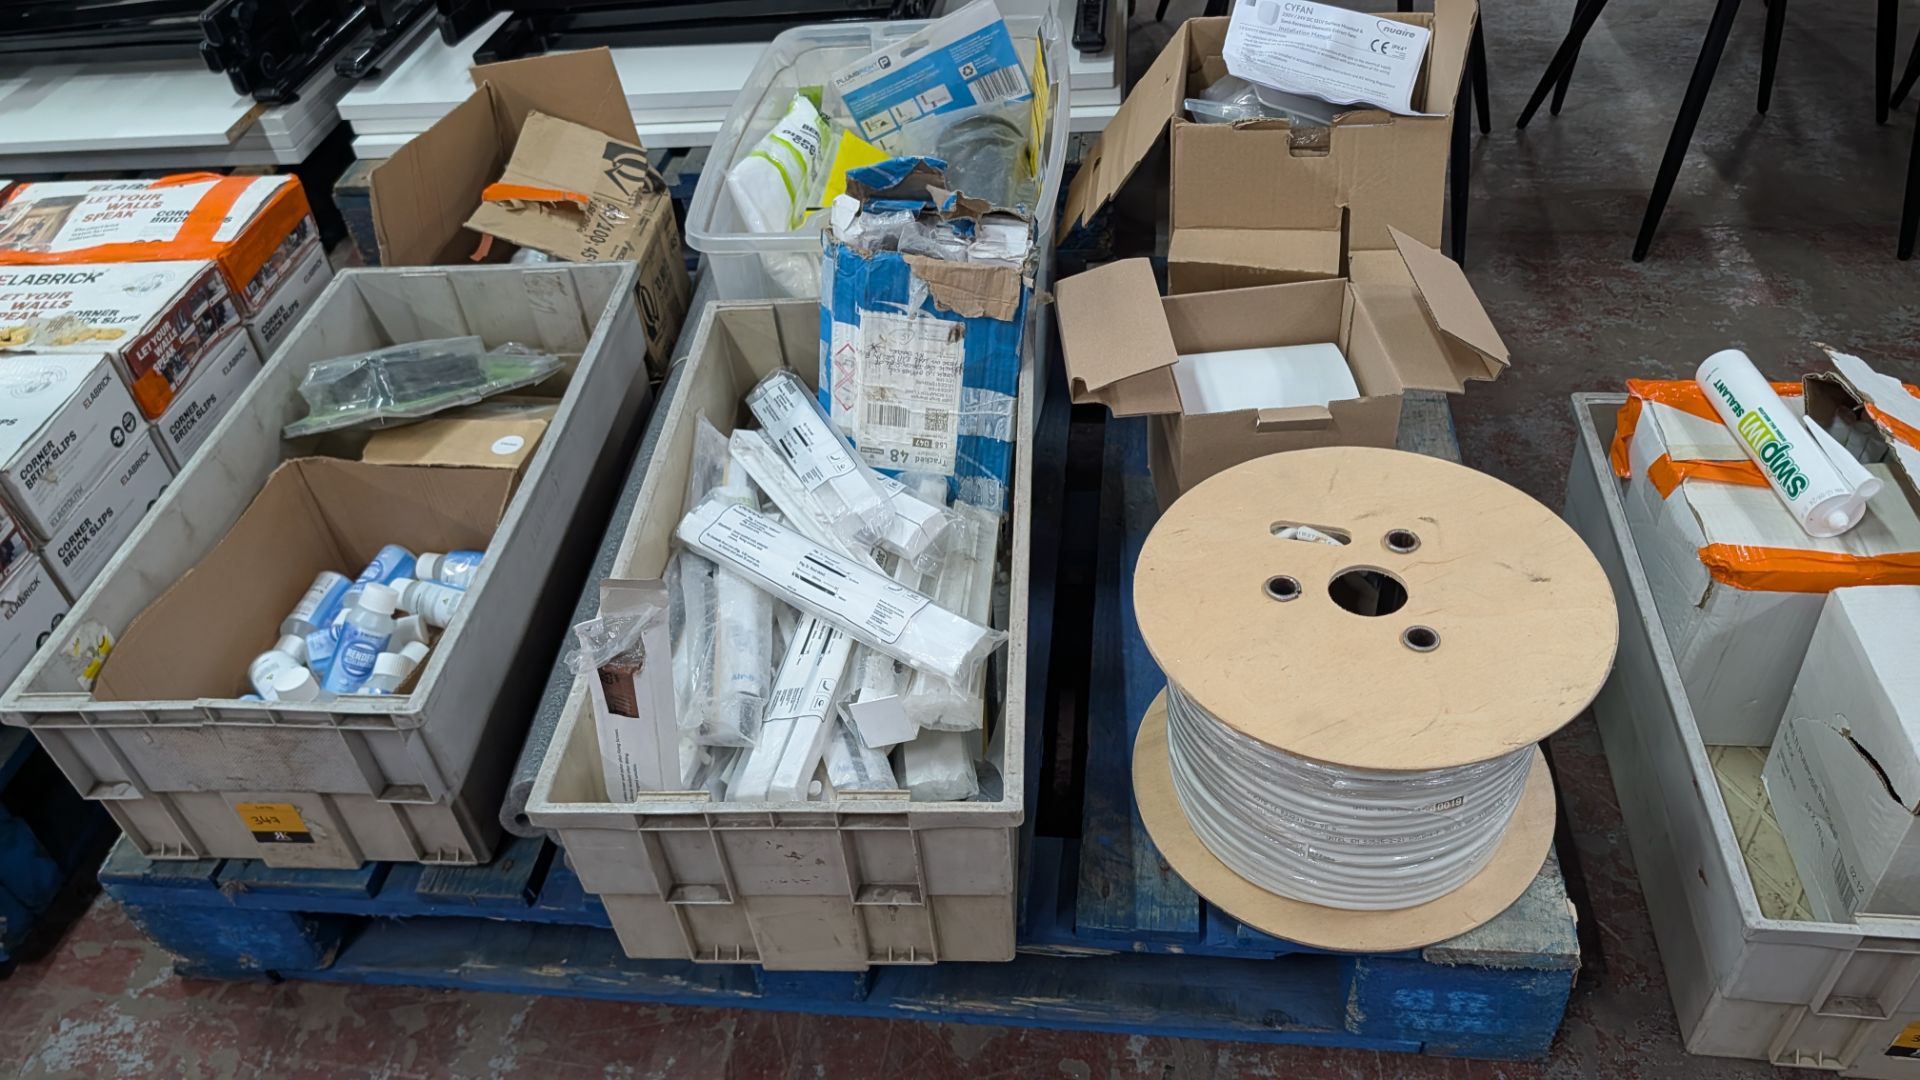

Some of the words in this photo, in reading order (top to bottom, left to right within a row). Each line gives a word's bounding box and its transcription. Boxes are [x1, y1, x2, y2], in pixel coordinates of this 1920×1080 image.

[1284, 2, 1314, 15] CYFAN
[1383, 25, 1416, 39] nuaire
[87, 194, 121, 204] LET
[119, 193, 163, 202] YOUR
[105, 201, 163, 211] WALLS
[82, 211, 136, 223] SPEAK
[156, 210, 191, 218] CORN
[0, 272, 104, 286] ELABRICK
[11, 300, 73, 311] WALLS
[24, 291, 73, 300] YOUR
[0, 311, 43, 320] PEAK
[101, 314, 141, 324] SLIPS
[261, 304, 286, 334] CORNER
[264, 317, 284, 343] BRICK
[282, 300, 300, 326] SLIPS
[135, 342, 153, 361] LET
[151, 320, 173, 348] YOUR
[154, 328, 177, 357] WALLS
[153, 347, 176, 374] SPEAK
[83, 373, 112, 410] ELABRICK
[1713, 378, 1745, 418] SEALANT
[169, 401, 199, 435] CORNER
[173, 414, 198, 444] BRICK
[194, 393, 217, 421] SLIPS
[20, 440, 55, 480] CORNER
[24, 458, 54, 490] BRICK
[51, 430, 78, 463] SLIPS
[120, 449, 152, 487] ELABRICK
[890, 448, 910, 464] 48
[914, 451, 948, 466] Tracked
[57, 517, 93, 558] CORNER
[62, 533, 90, 567] BRICK
[88, 506, 114, 538] SLIPS
[4, 576, 41, 620] ELABRICK
